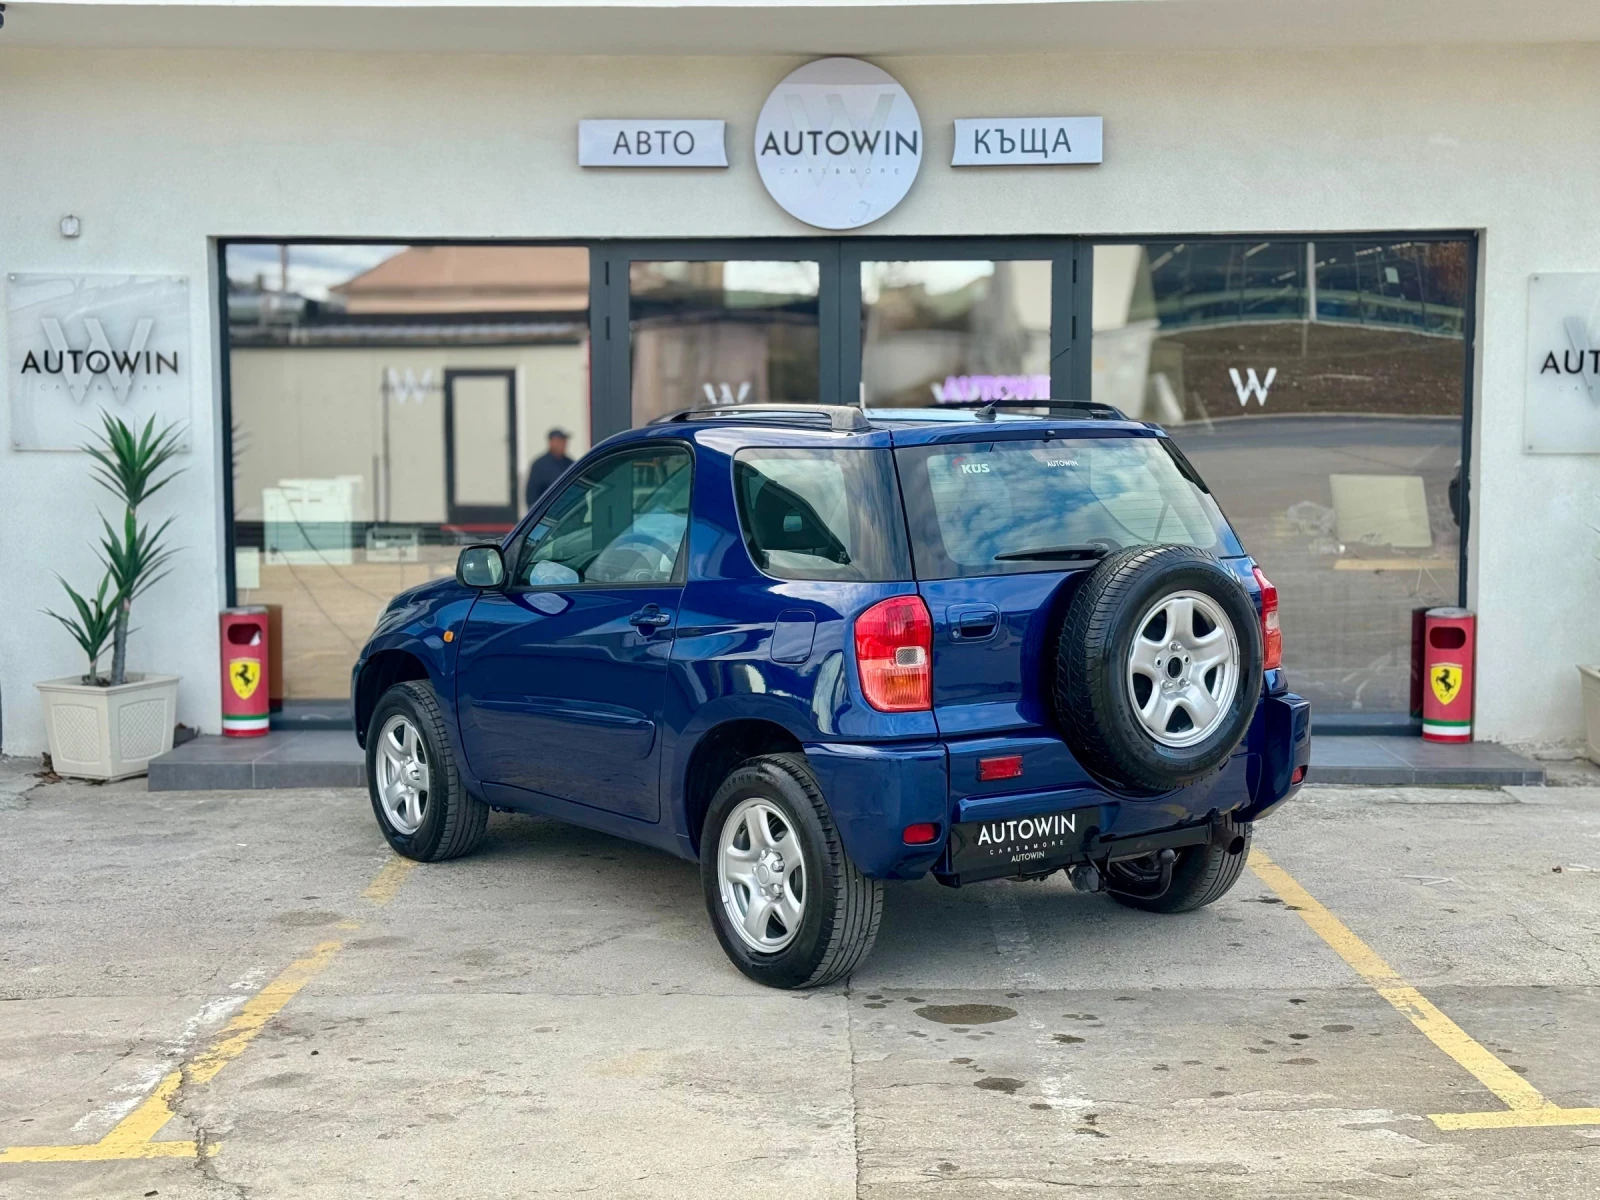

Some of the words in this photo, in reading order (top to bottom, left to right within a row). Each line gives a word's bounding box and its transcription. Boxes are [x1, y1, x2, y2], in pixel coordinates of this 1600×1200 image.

[612, 130, 695, 156] АВТО
[760, 130, 918, 156] AUTOWIN
[974, 127, 1072, 159] КЪЩА
[20, 349, 179, 375] AUTOWIN
[40, 318, 154, 406] W
[388, 366, 433, 406] W
[1228, 367, 1277, 407] W
[978, 814, 1076, 845] AUTOWIN
[1010, 851, 1045, 863] AUTOWIN
